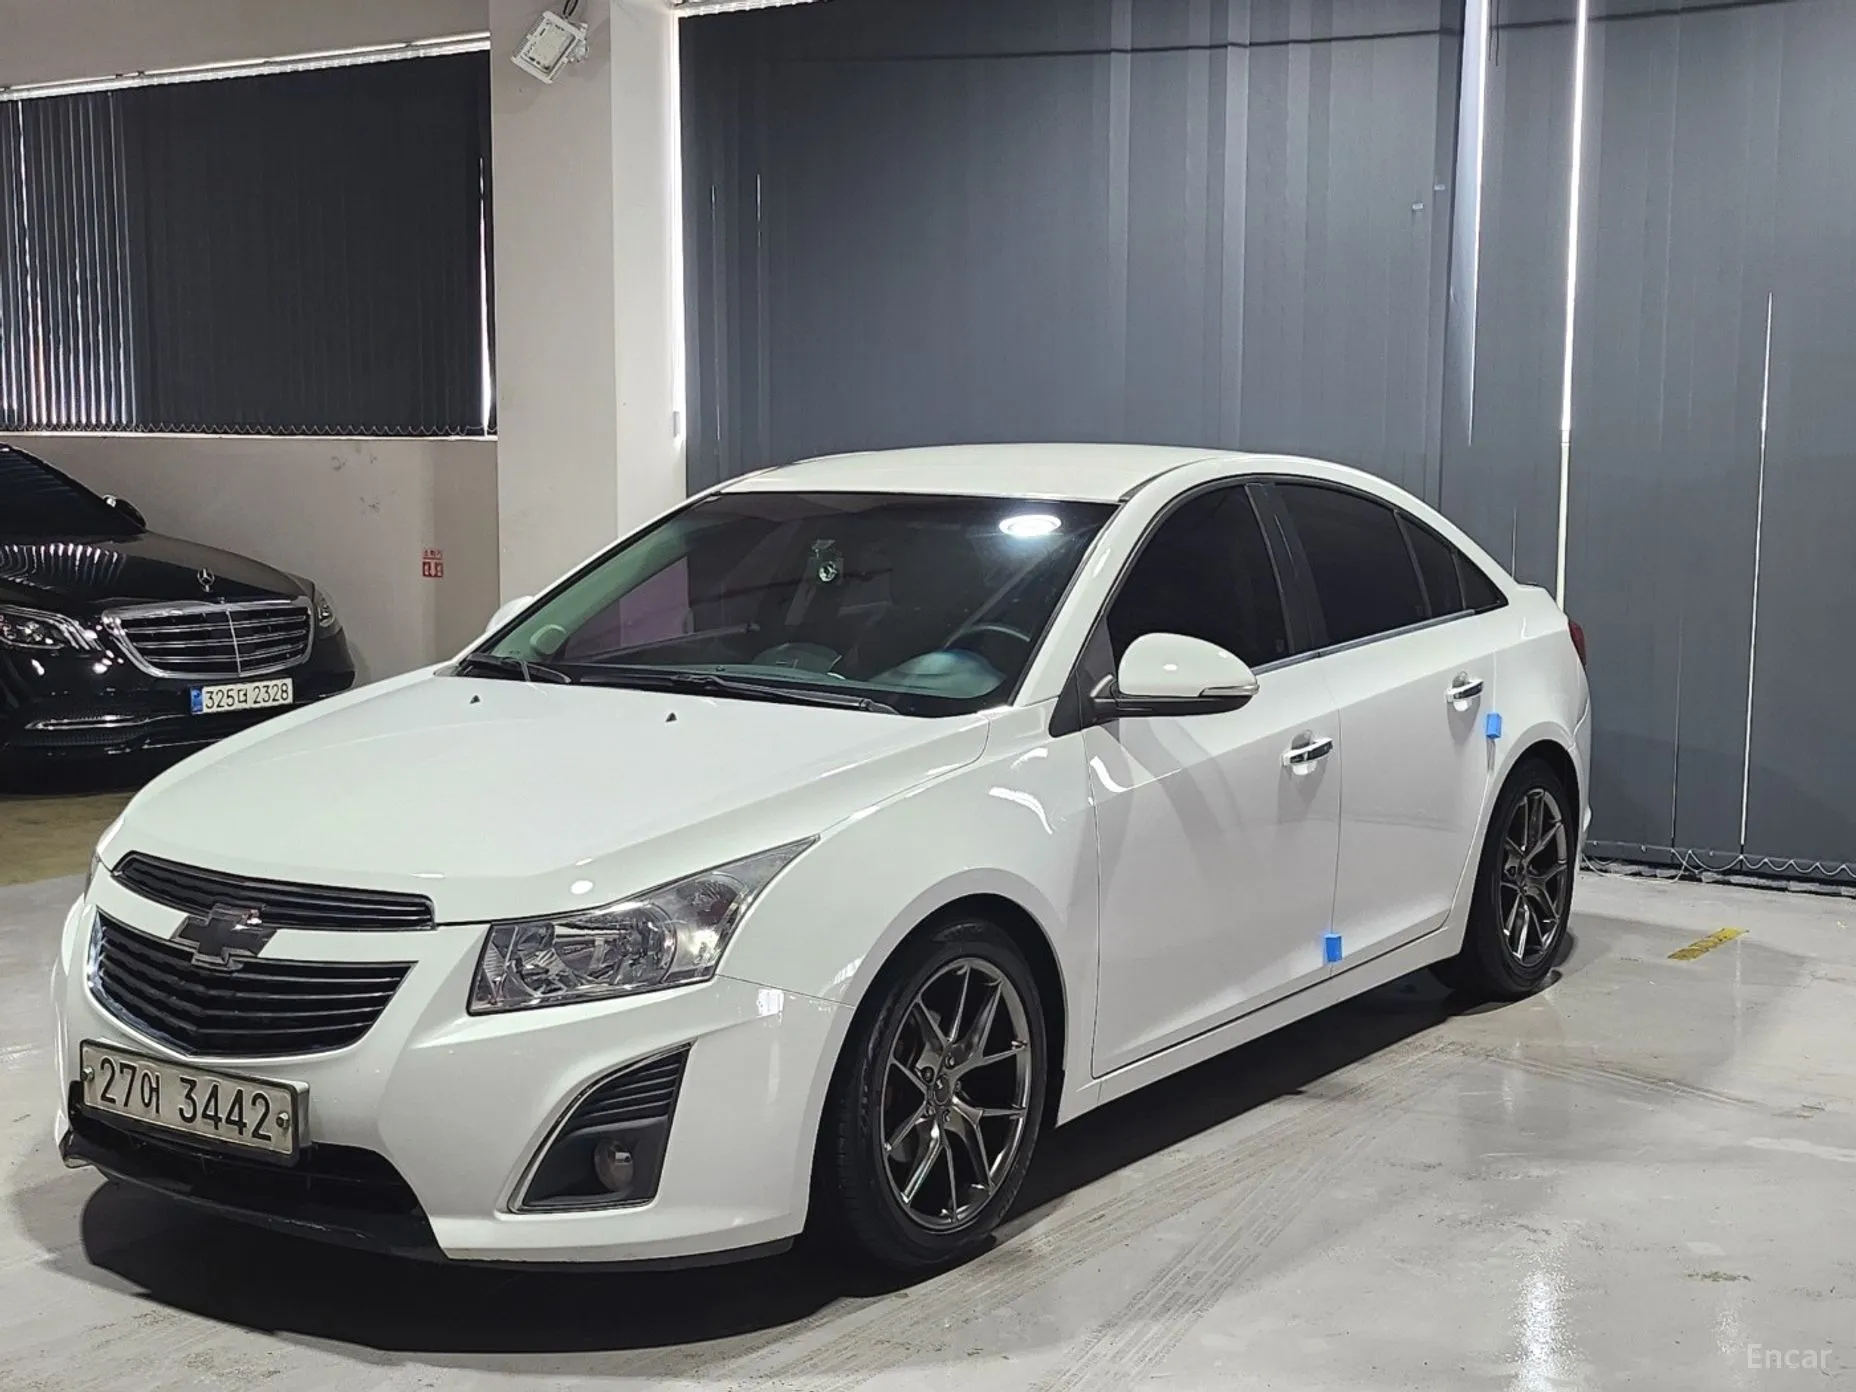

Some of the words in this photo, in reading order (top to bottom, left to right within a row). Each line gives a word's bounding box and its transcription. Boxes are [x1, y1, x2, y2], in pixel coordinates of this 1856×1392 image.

[205, 687, 248, 709] 325더
[252, 682, 289, 704] 2328
[99, 1056, 161, 1114] 27어
[178, 1076, 273, 1142] 3442
